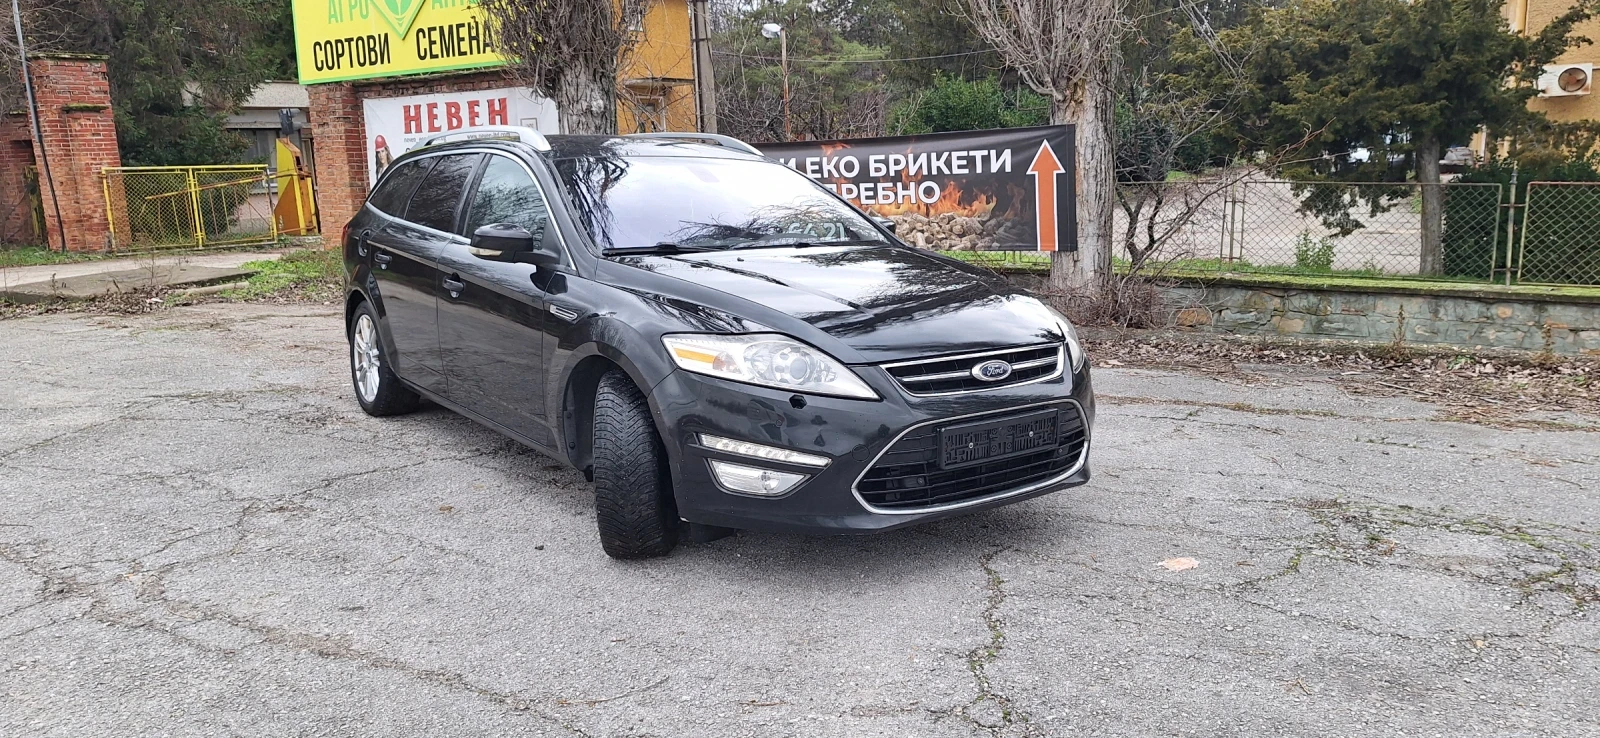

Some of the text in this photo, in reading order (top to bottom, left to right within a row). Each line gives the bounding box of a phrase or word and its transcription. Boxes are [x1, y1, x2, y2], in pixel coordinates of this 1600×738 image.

[313, 21, 495, 71] СОРТОВИ СЕМЕНА
[403, 98, 508, 134] НЕВЕН
[806, 156, 859, 178] ЕКО
[868, 149, 1012, 177] БРИКЕТИ
[987, 365, 1004, 376] Ford
